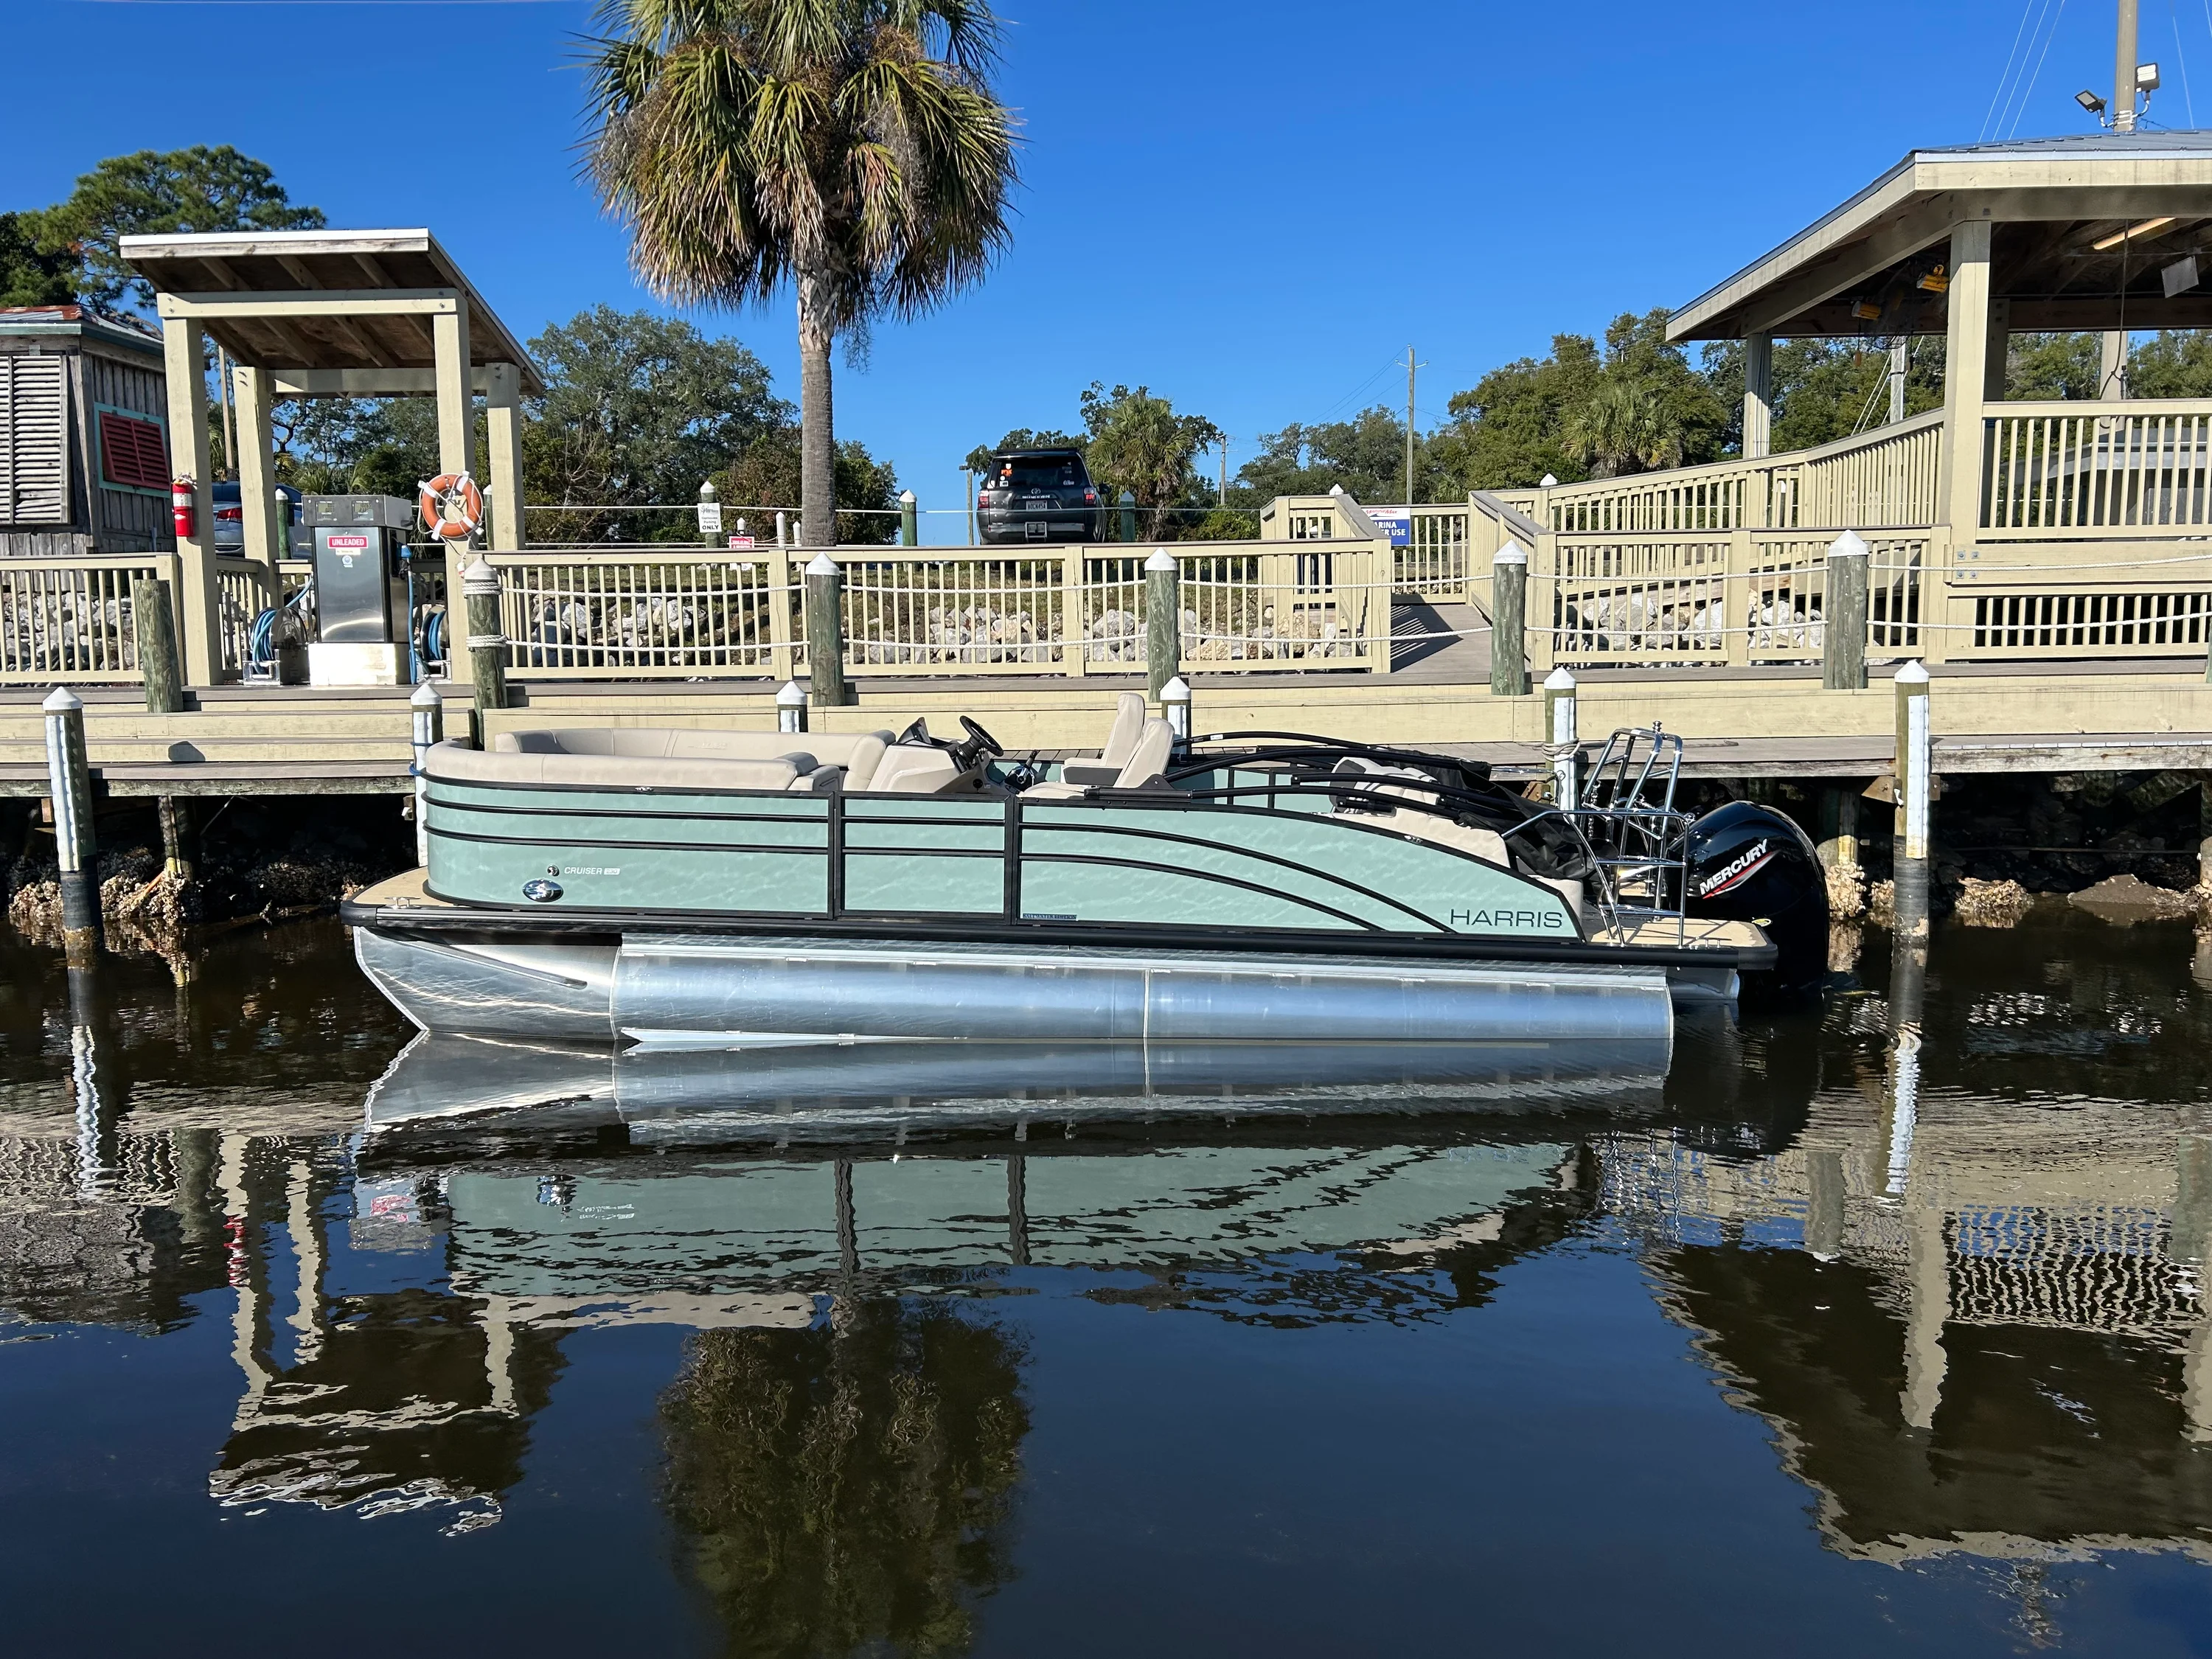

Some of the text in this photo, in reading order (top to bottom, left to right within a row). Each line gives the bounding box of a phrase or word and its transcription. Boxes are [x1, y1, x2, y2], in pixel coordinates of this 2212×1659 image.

[564, 866, 602, 875] CRUISER
[1700, 838, 1767, 895] MERCURY
[1450, 908, 1562, 928] HARRIS
